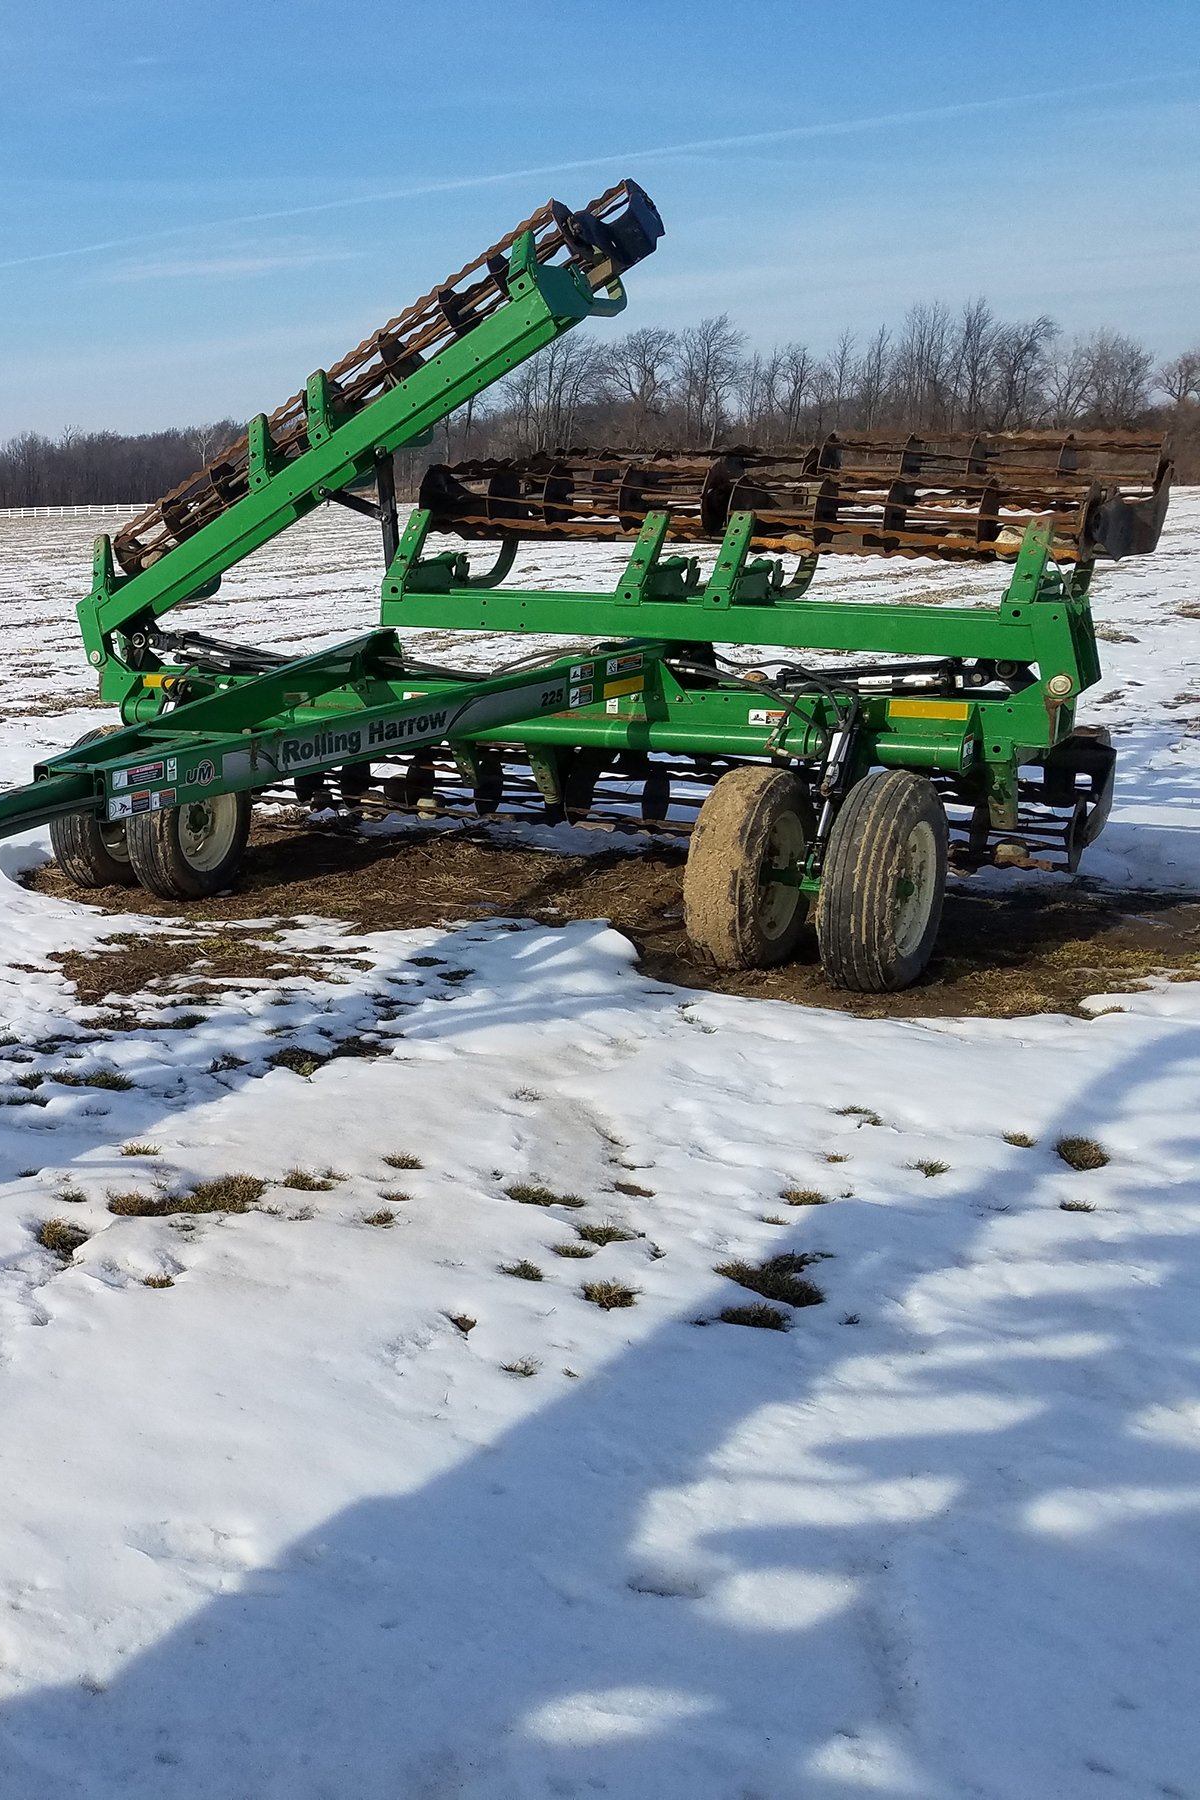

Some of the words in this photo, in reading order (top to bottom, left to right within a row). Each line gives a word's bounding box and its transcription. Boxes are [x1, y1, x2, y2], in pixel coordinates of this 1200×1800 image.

[541, 688, 563, 707] 225
[282, 729, 362, 764] Rolling
[368, 710, 448, 745] Harrow
